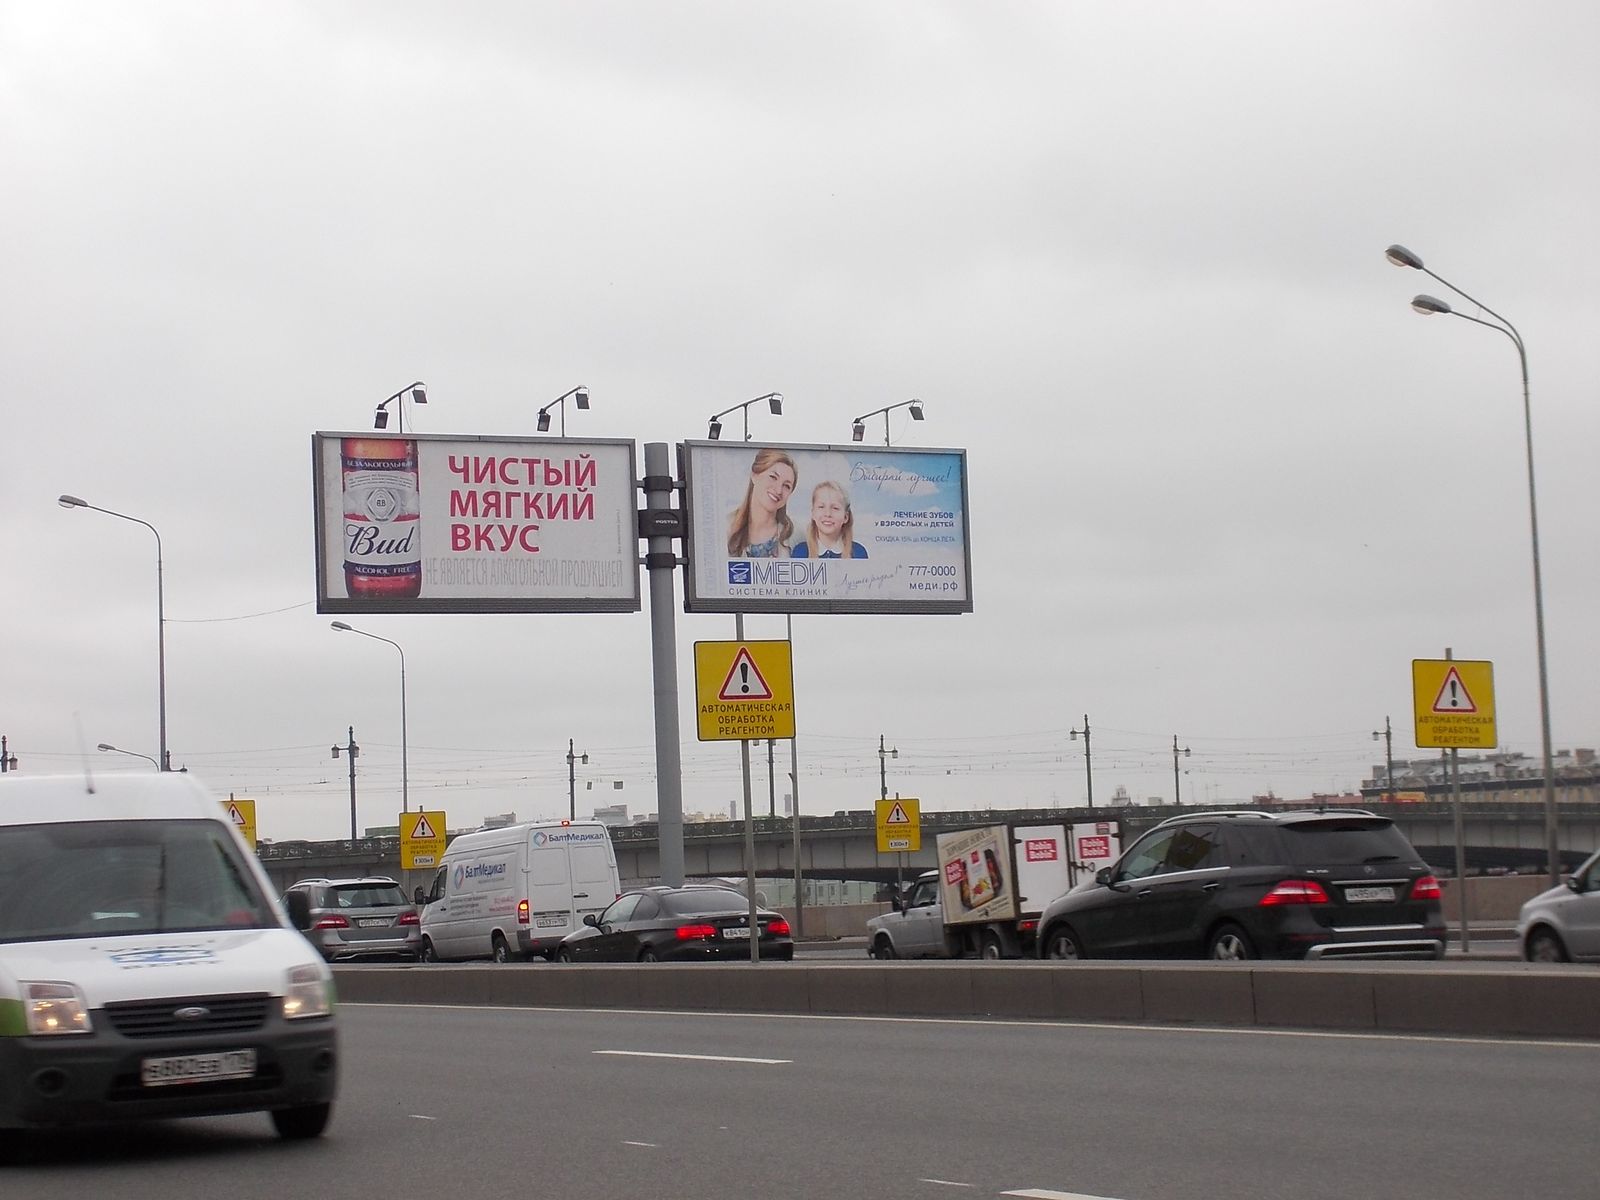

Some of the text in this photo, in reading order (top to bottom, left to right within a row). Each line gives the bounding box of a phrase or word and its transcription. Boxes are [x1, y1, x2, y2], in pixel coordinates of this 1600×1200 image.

[448, 453, 597, 487] ЧИСТЫЙ
[450, 487, 595, 520] МЯГКИЙ
[893, 511, 954, 519] ЛЕЧЕНИЕ ЗУБОВ
[880, 520, 922, 528] ВЗРОСЛЫХ
[930, 520, 954, 528] ДЕТЕЙ
[346, 523, 415, 556] Bud
[451, 523, 540, 553] ВКУС
[355, 566, 390, 575] ALCOHOL
[425, 557, 623, 588] НЕ ЯВЛЯЕТСЯ АЛКОГОЛЬНОЙ ПРОДУКЦИЕЙ
[908, 565, 957, 577] 777-0000
[728, 588, 829, 596] СИСТЕМА КЛИНИК
[909, 581, 959, 592] меди.рф
[701, 703, 791, 714] АВТОМАТИЧЕСКАЯ
[718, 715, 775, 724] ОБРАБОТКА
[719, 725, 775, 735] РЕАГЕНТОМ
[548, 833, 605, 843] БалтМедикал
